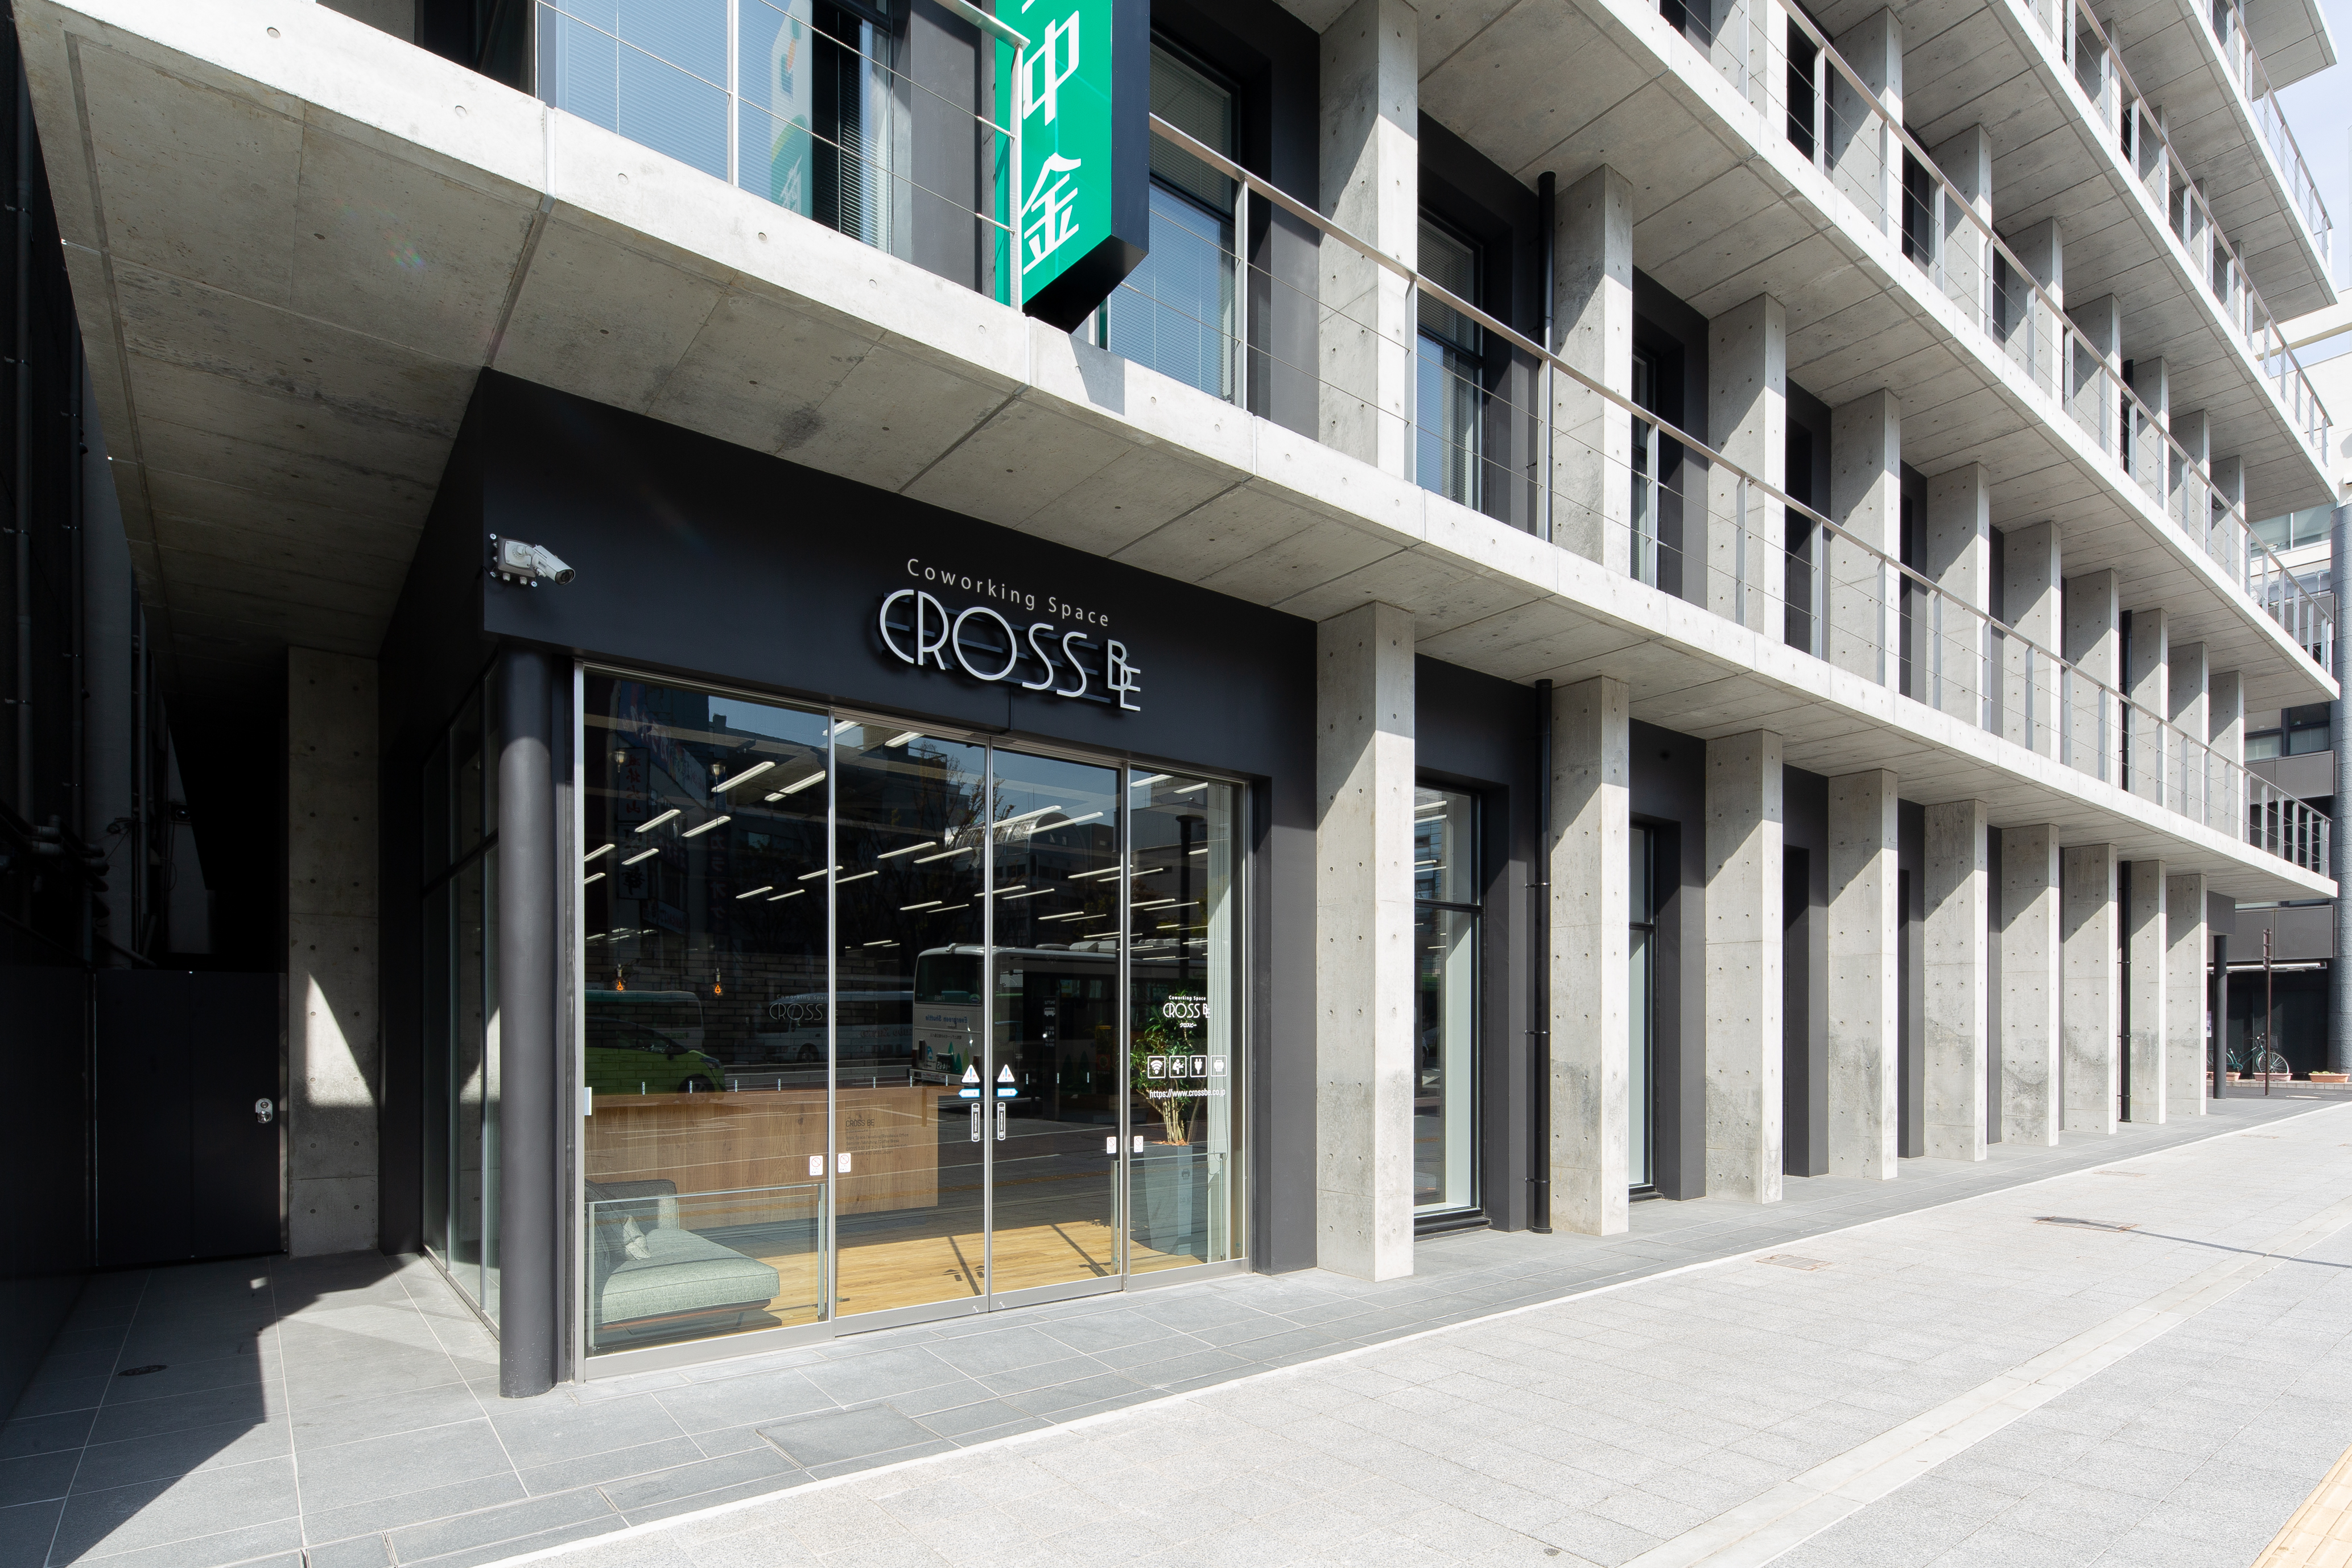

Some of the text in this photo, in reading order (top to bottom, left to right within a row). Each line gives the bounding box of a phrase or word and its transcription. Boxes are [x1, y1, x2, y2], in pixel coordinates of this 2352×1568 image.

[1021, 0, 1081, 275] 中金
[907, 558, 1109, 626] Coworking Space
[880, 589, 1141, 711] CROSS BE
[769, 1002, 823, 1020] CROSS
[1163, 1002, 1211, 1018] CROSS BE
[1149, 1088, 1226, 1100] https://www.crossbe.co.jp
